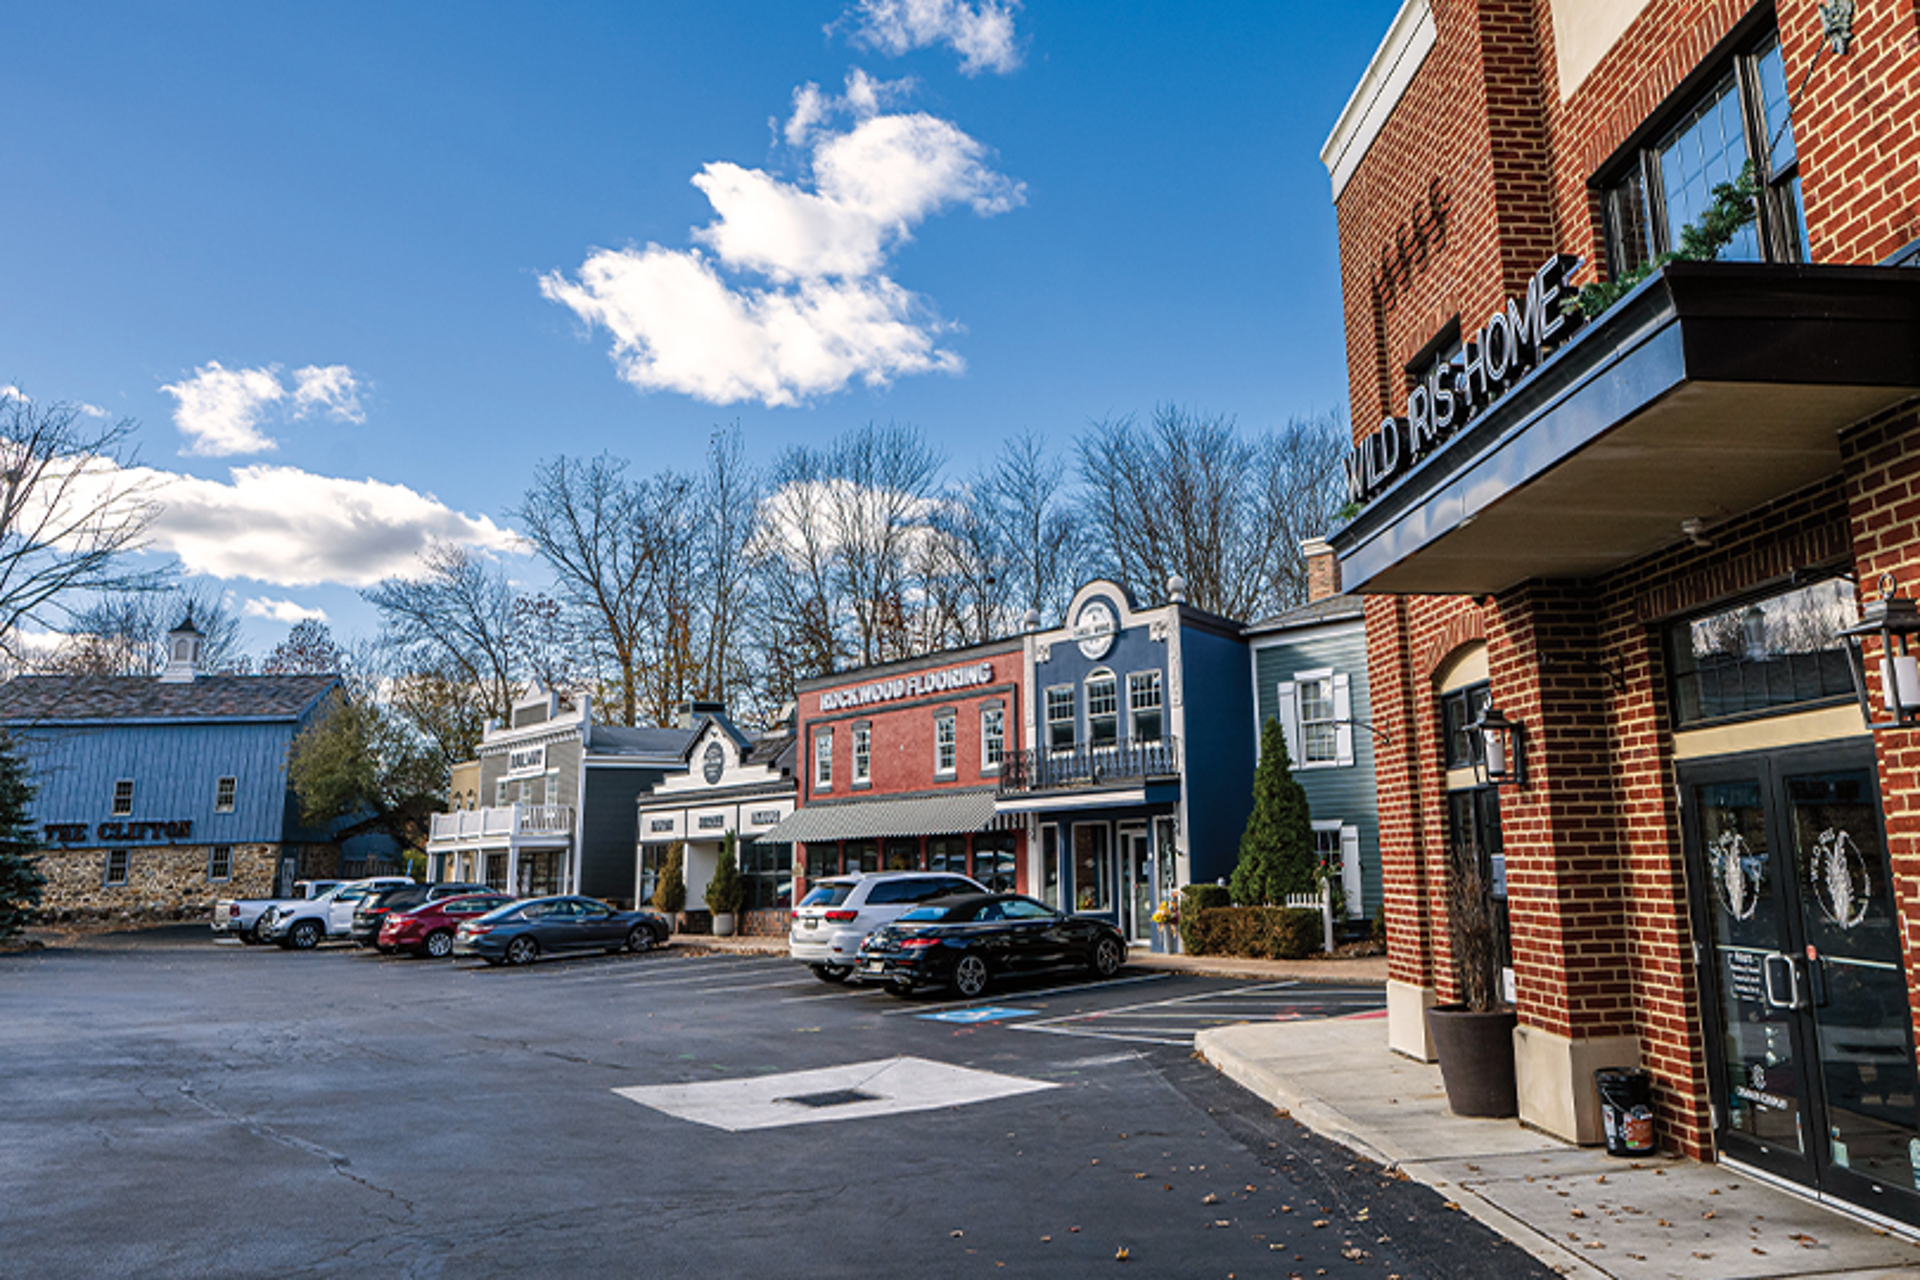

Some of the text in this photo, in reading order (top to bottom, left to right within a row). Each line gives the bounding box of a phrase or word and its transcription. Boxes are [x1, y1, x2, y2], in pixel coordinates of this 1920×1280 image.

[1342, 253, 1566, 503] WILD IRIS HOME
[906, 661, 993, 696] FLOORING
[44, 820, 192, 842] THE CLIFTON
